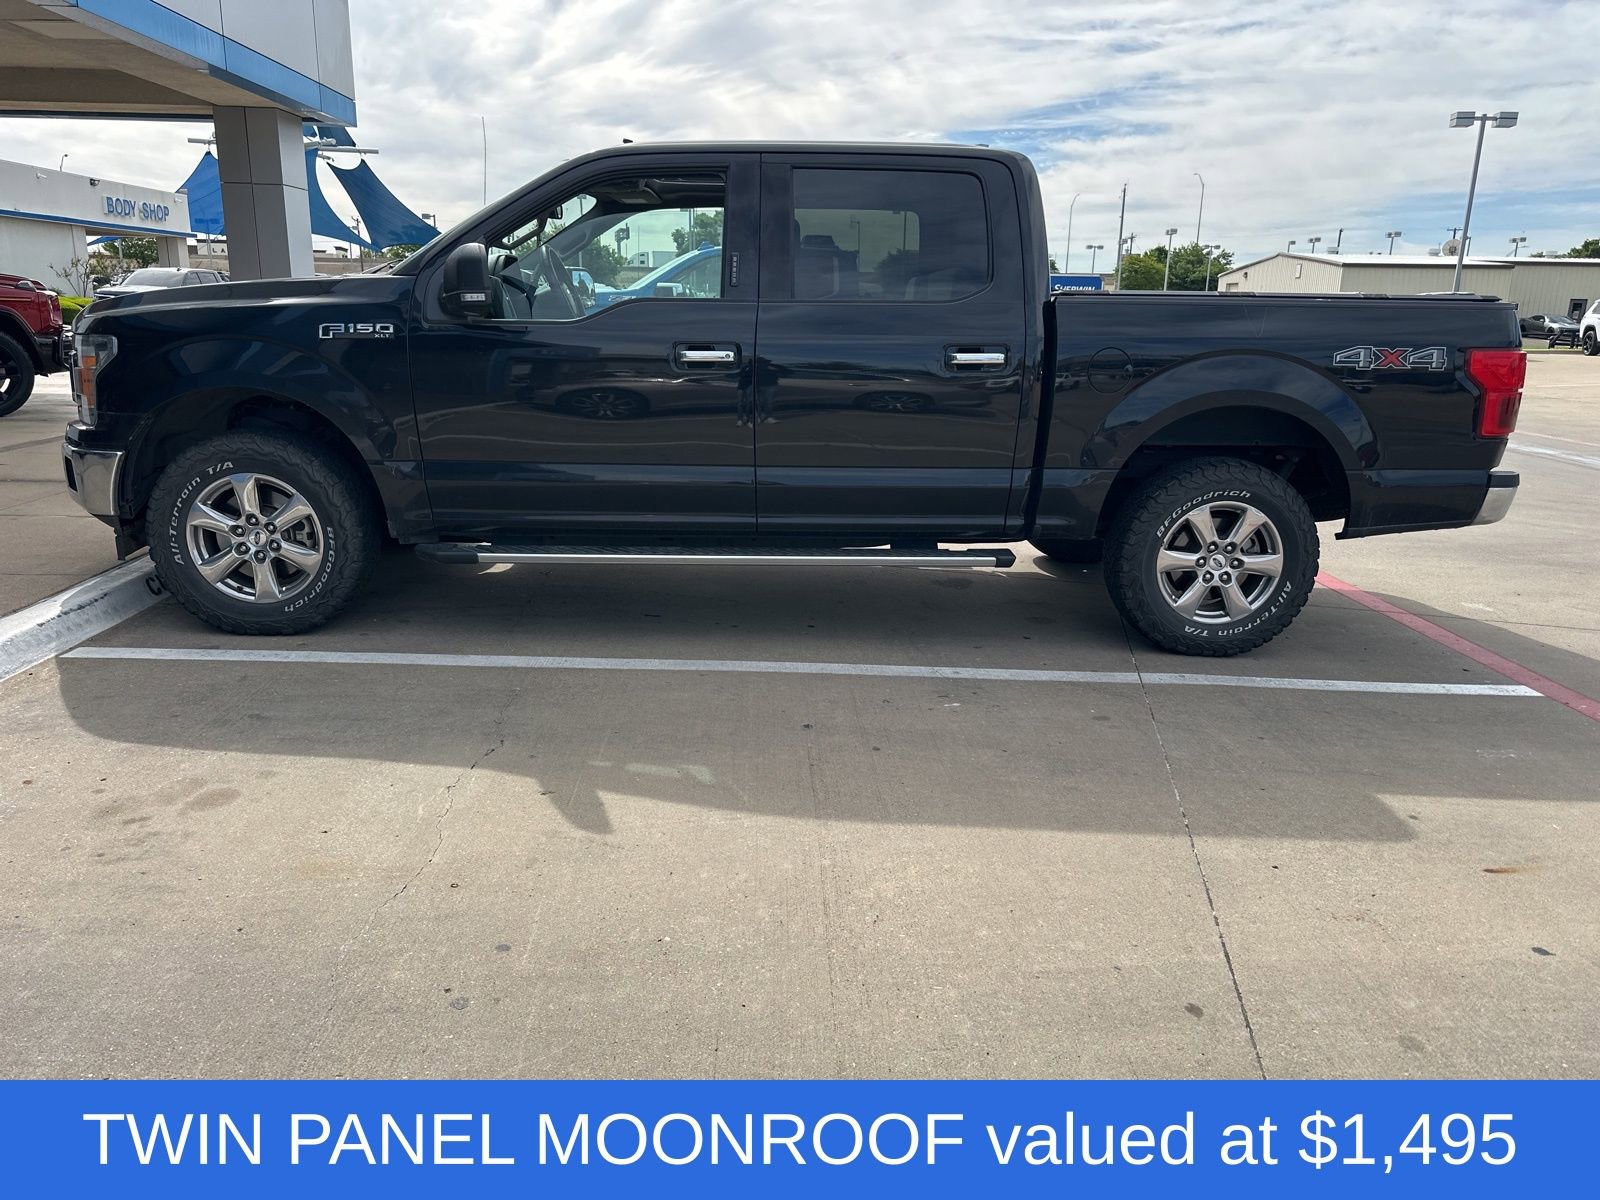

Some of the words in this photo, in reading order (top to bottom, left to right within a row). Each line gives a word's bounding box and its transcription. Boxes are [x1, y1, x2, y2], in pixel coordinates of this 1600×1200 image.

[106, 196, 136, 218] BODY
[142, 202, 170, 222] SHOP
[168, 475, 201, 566] All-Terrain
[206, 461, 235, 476] T/A
[1156, 489, 1251, 539] BFGoodrich
[284, 525, 336, 613] BFGoodrich
[1184, 624, 1210, 638] T/A
[1218, 580, 1294, 637] All-Terrain
